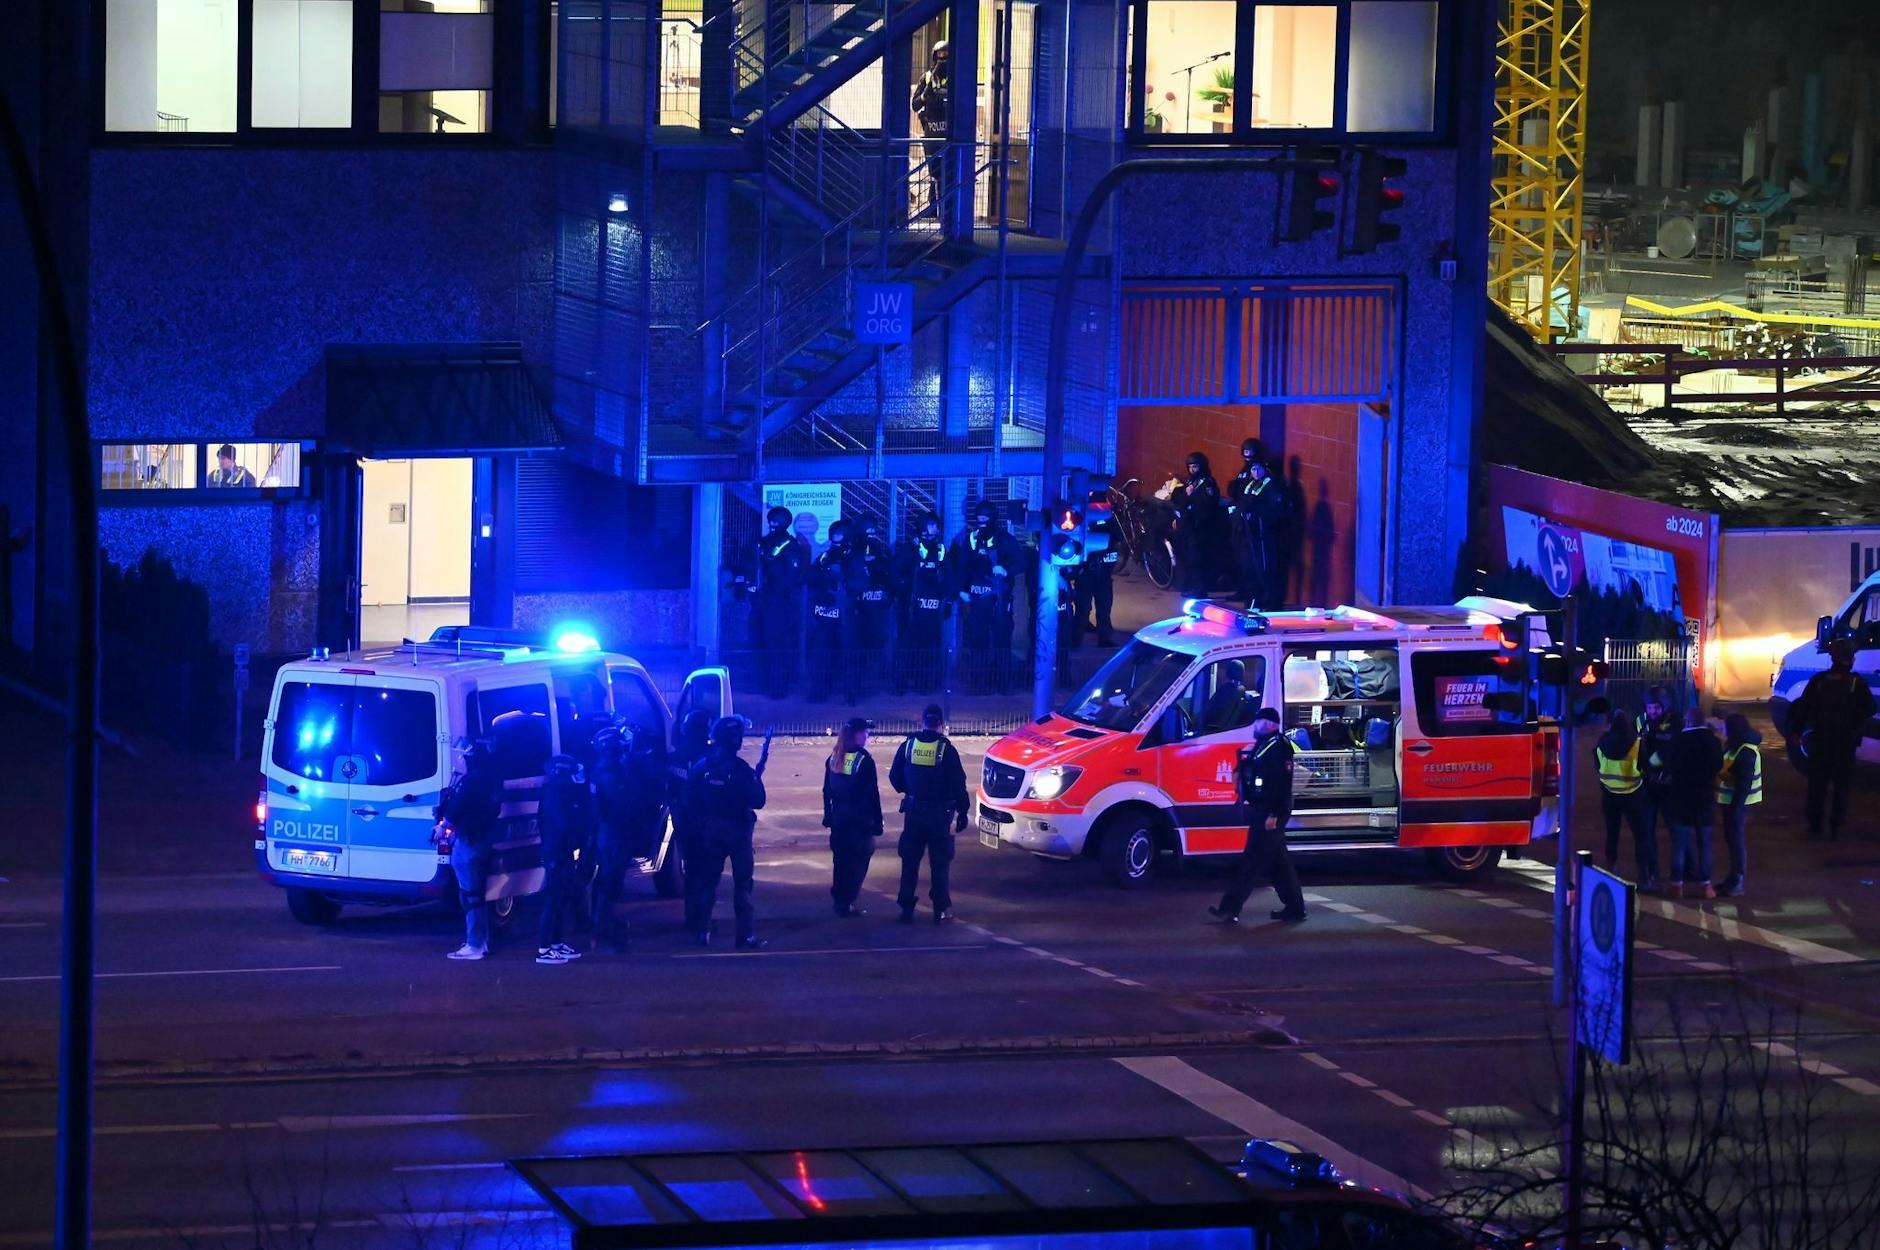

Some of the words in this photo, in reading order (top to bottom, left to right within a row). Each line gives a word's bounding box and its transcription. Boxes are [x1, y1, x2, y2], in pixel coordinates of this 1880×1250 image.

[867, 293, 902, 315] JW
[1666, 515, 1678, 531] ab
[1679, 517, 1703, 538] 2024
[1446, 683, 1474, 693] FEUER
[1475, 683, 1487, 692] IM
[1444, 693, 1485, 705] HERZEN
[1423, 763, 1494, 772] FEUERWEHR
[273, 820, 339, 841] POLIZEI
[291, 855, 303, 865] HH
